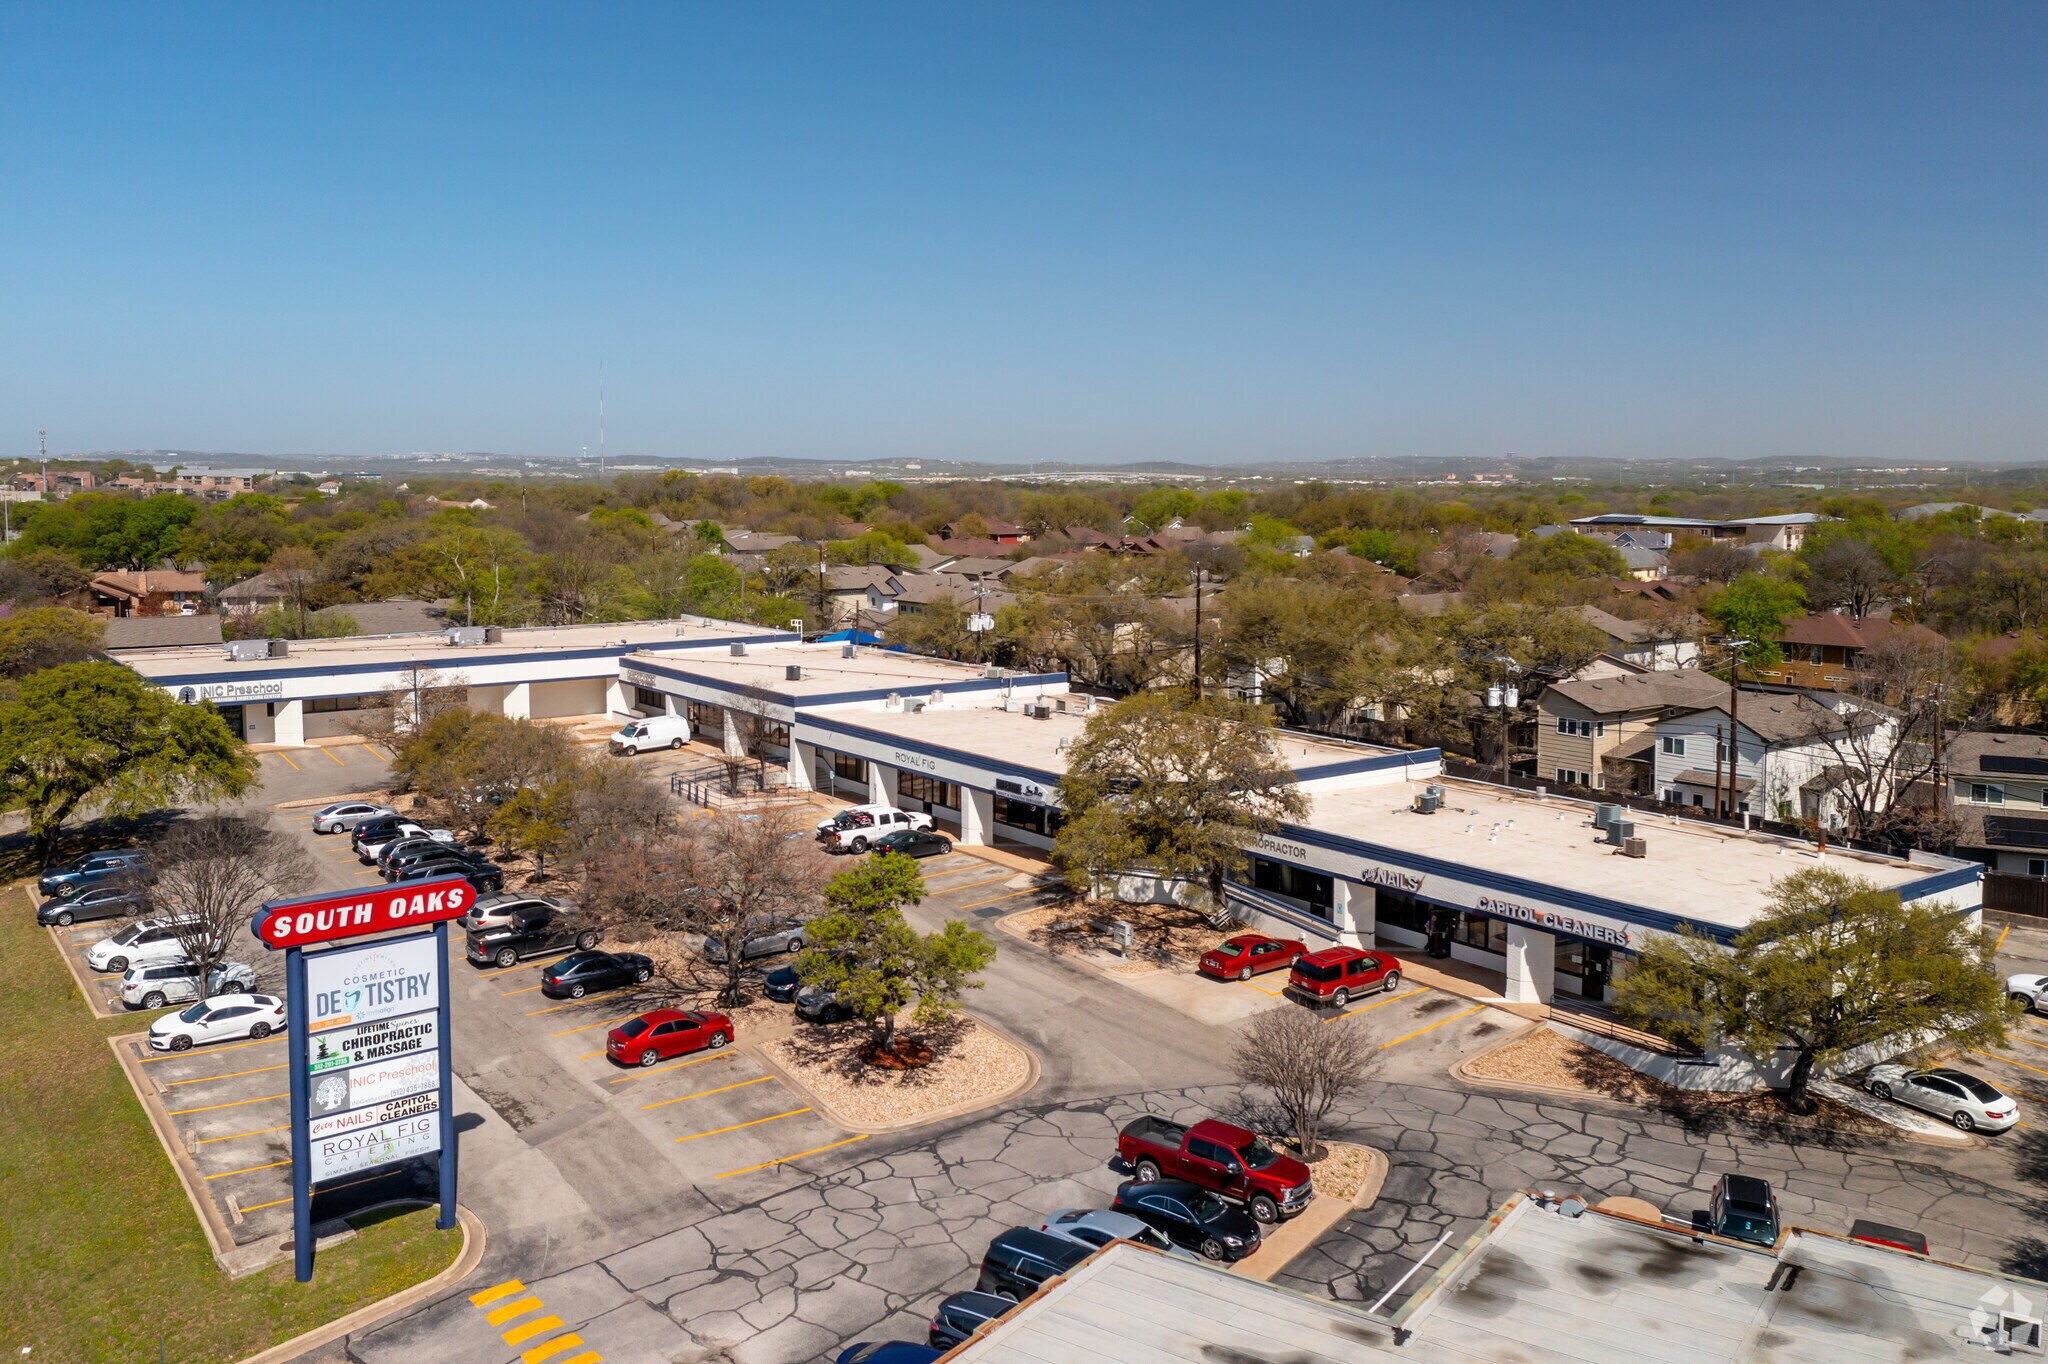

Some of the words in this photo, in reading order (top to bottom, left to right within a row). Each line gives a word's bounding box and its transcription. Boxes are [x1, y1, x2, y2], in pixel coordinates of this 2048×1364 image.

[199, 685, 224, 697] INIC
[226, 681, 283, 696] Preschool
[895, 751, 920, 767] ROYAL
[922, 758, 936, 770] FIG
[1361, 867, 1378, 882] City
[1376, 868, 1420, 892] NAILS
[272, 902, 373, 938] SOUTH
[388, 888, 464, 919] OAKS
[1477, 896, 1538, 924] CAPITOL
[1542, 912, 1629, 946] CLEANERS
[343, 967, 406, 986] COSMETIC
[342, 1022, 433, 1052] CHIROPRACTIC
[356, 1022, 390, 1036] LIFETIME
[353, 1050, 365, 1062] &
[367, 1037, 422, 1060] MASSAGE
[349, 1073, 379, 1089] INIC
[379, 1060, 435, 1082] Preschool
[380, 1100, 438, 1122] CLEANERS
[386, 1094, 431, 1112] CAPITOL
[312, 1121, 333, 1134] City
[336, 1111, 373, 1129] NAILS
[323, 1129, 391, 1156] ROYAL
[397, 1118, 430, 1137] FIG
[325, 1132, 430, 1166] CATERING
[405, 1145, 430, 1156] FRESH
